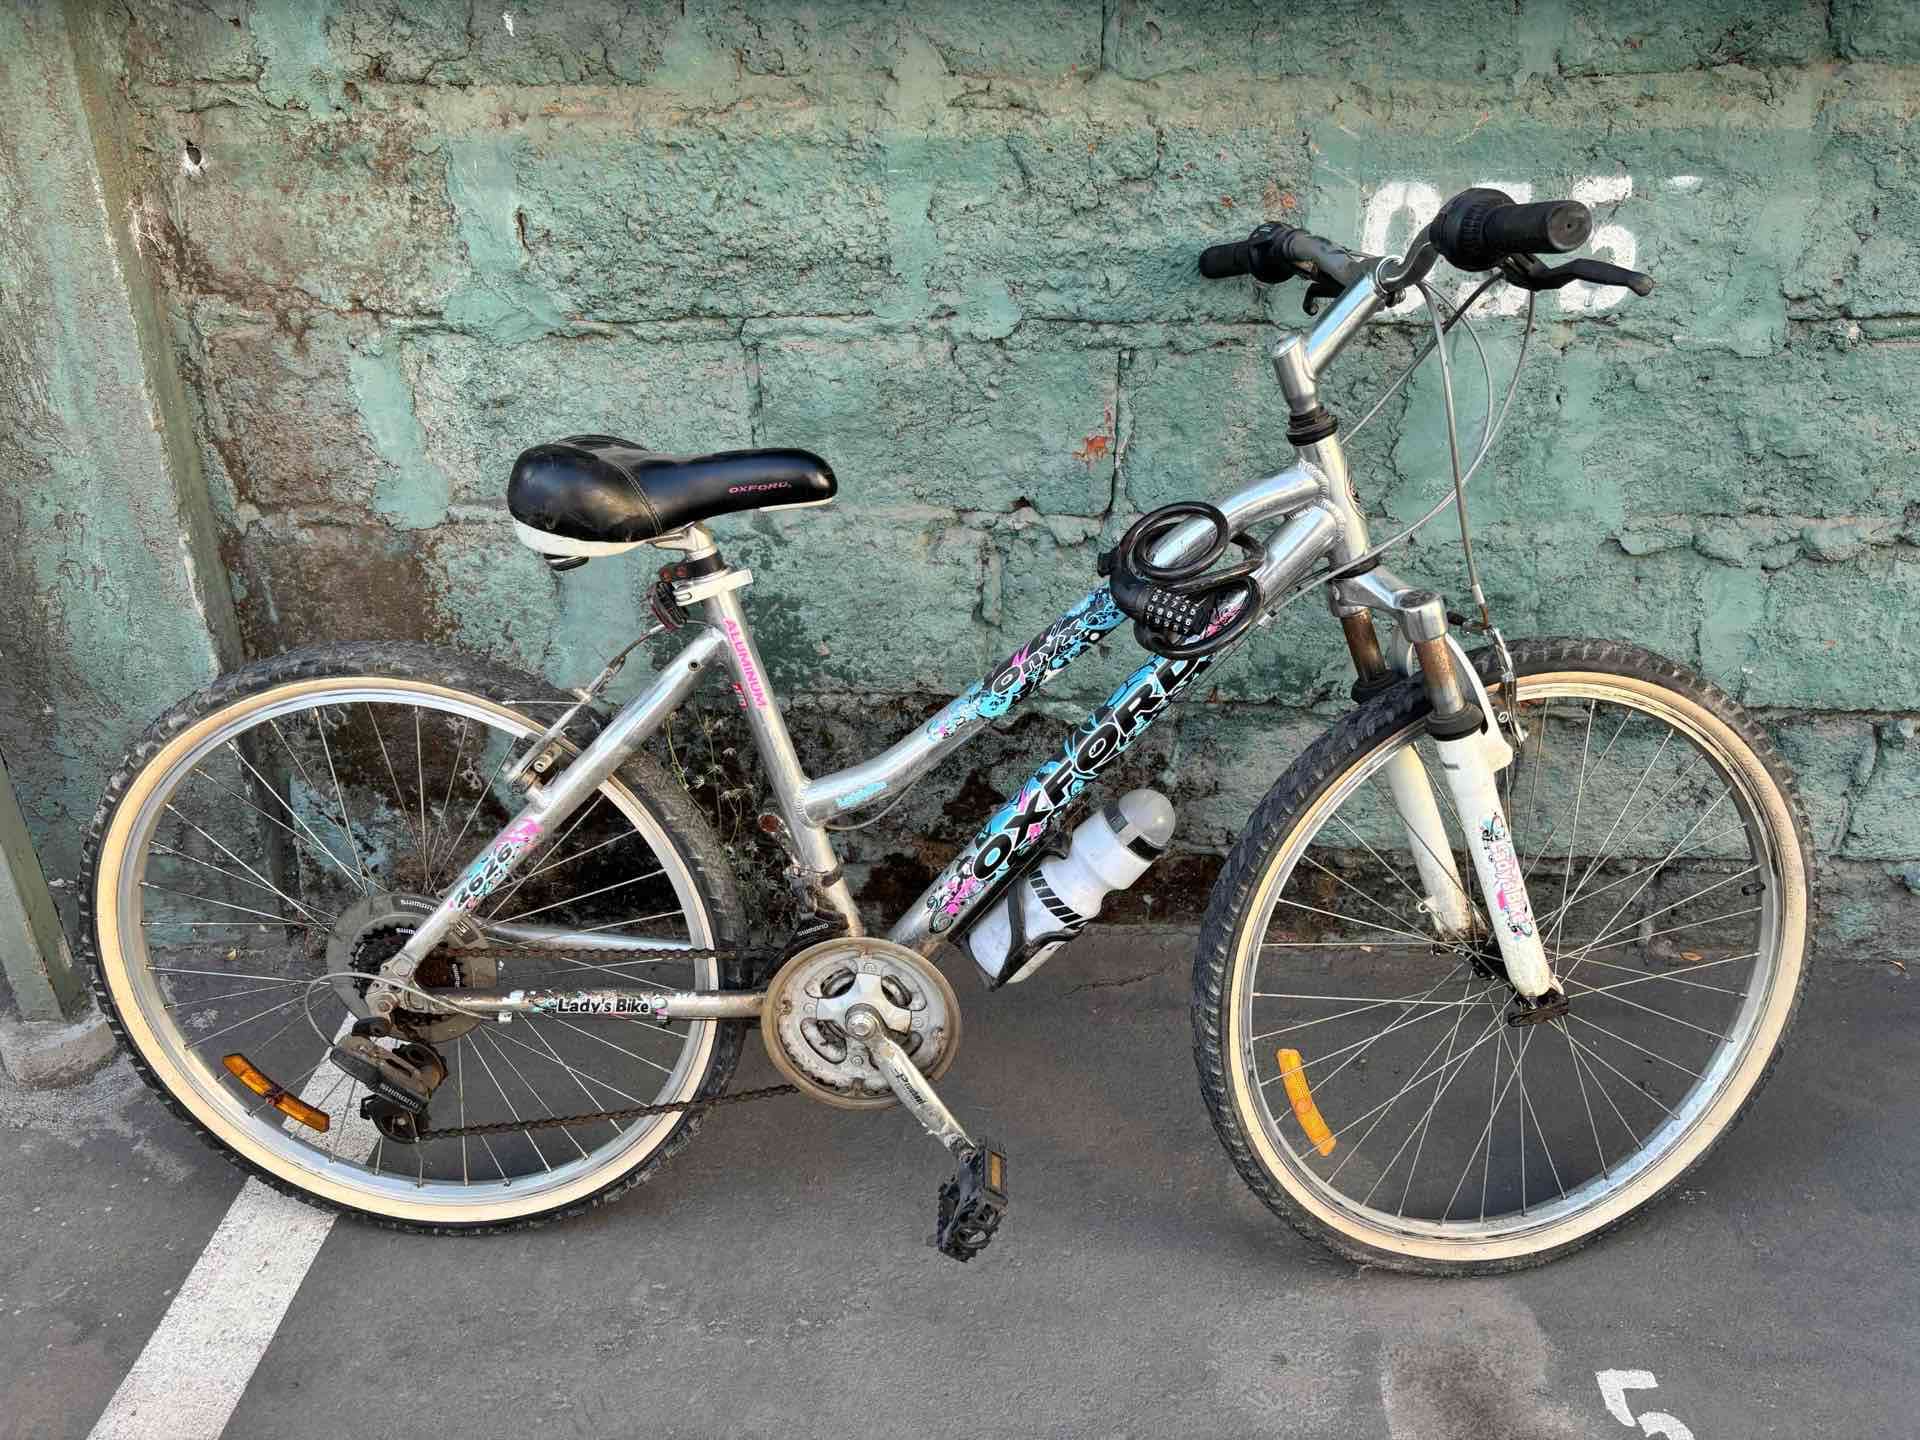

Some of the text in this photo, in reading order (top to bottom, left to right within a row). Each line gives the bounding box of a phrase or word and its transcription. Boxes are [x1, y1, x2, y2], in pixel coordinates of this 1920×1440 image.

[728, 480, 790, 494] OXFORD
[723, 618, 768, 707] ALUMINUM
[972, 655, 1202, 881] OXFORD
[557, 997, 649, 1014] Lady's Bike
